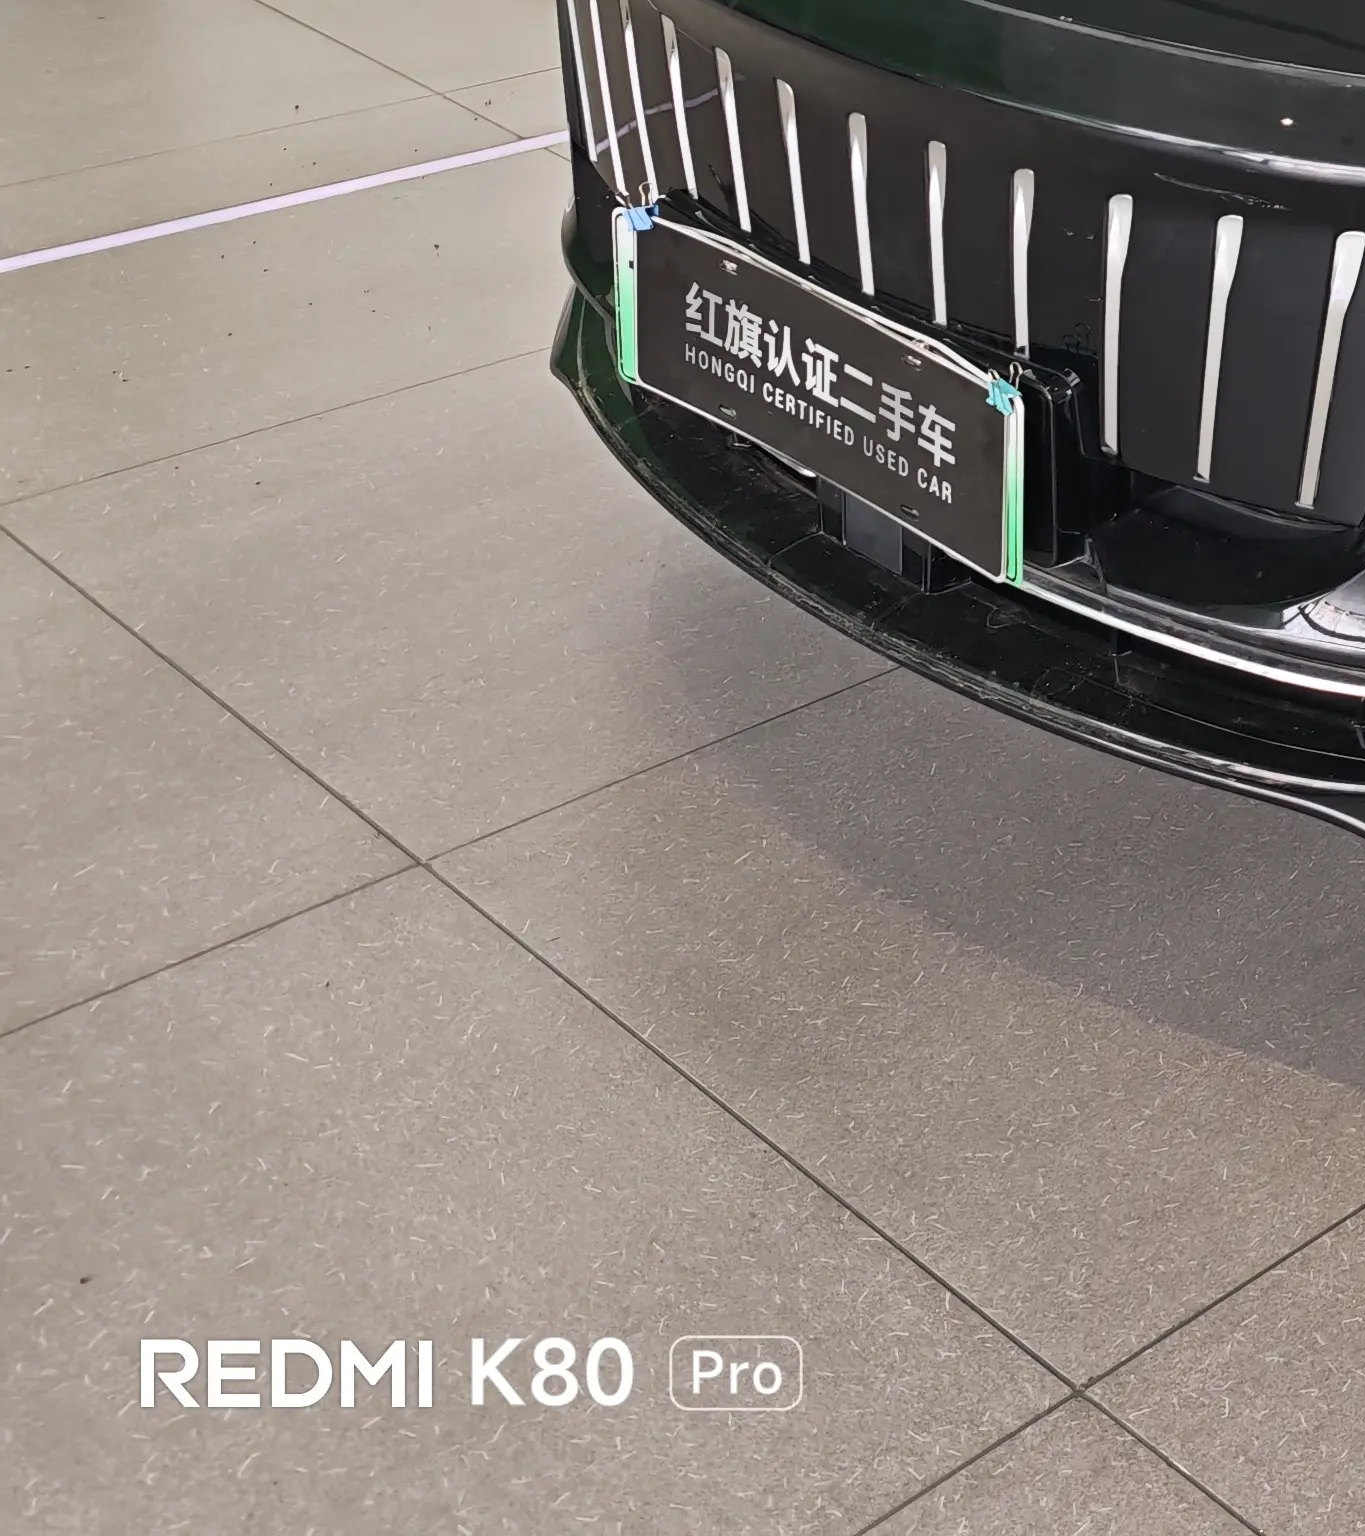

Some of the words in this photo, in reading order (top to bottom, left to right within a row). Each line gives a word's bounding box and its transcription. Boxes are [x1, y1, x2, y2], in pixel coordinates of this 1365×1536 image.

[684, 342, 755, 394] HONGQI
[762, 381, 855, 446] CERTIFIED
[863, 435, 909, 477] USED
[917, 467, 952, 504] CAR
[685, 281, 956, 468] 红旗认证二手车
